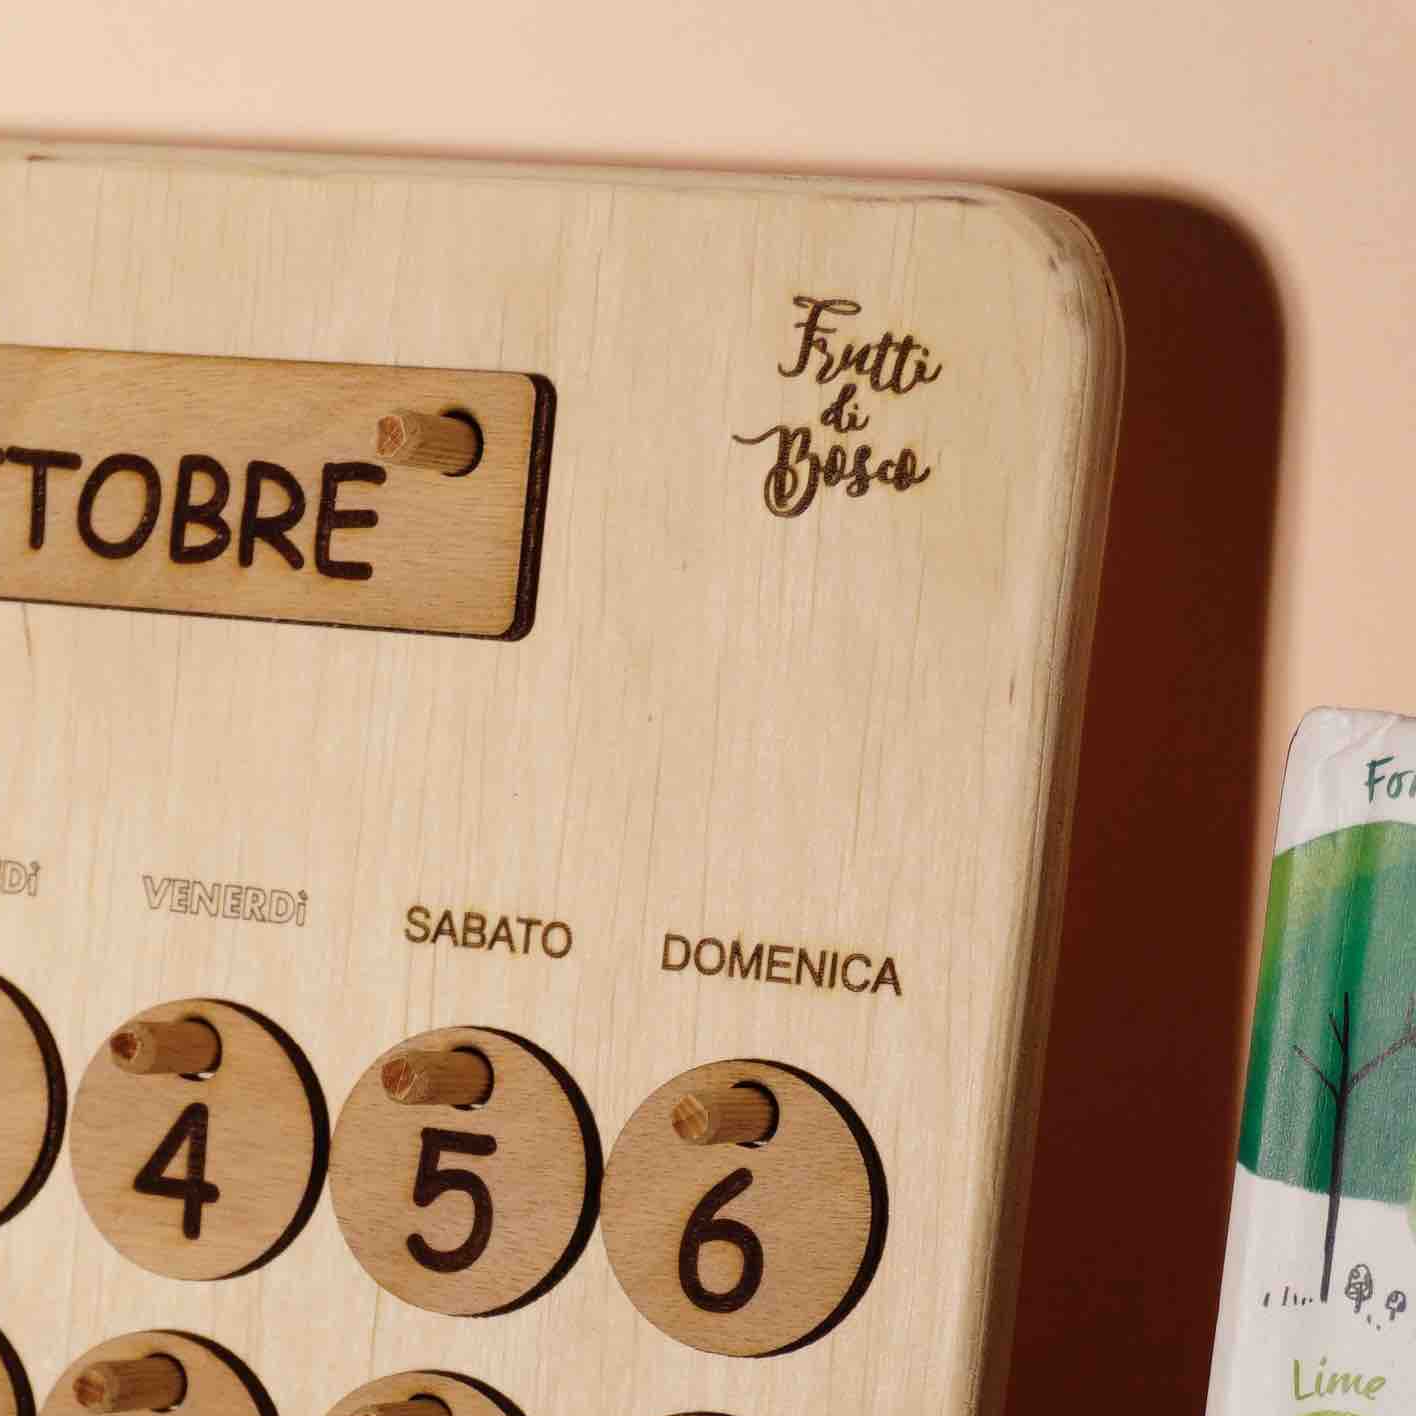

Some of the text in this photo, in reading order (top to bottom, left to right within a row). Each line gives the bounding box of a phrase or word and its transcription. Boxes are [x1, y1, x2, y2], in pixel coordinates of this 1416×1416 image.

[777, 295, 943, 394] Frutti
[820, 383, 870, 433] di
[731, 424, 931, 518] Bosco
[404, 904, 573, 960] SABATO
[661, 932, 903, 996] DOMENICA
[133, 1103, 219, 1241] 4
[406, 1127, 497, 1273] 5
[678, 1168, 764, 1313] 6
[1293, 1355, 1386, 1401] Lime
